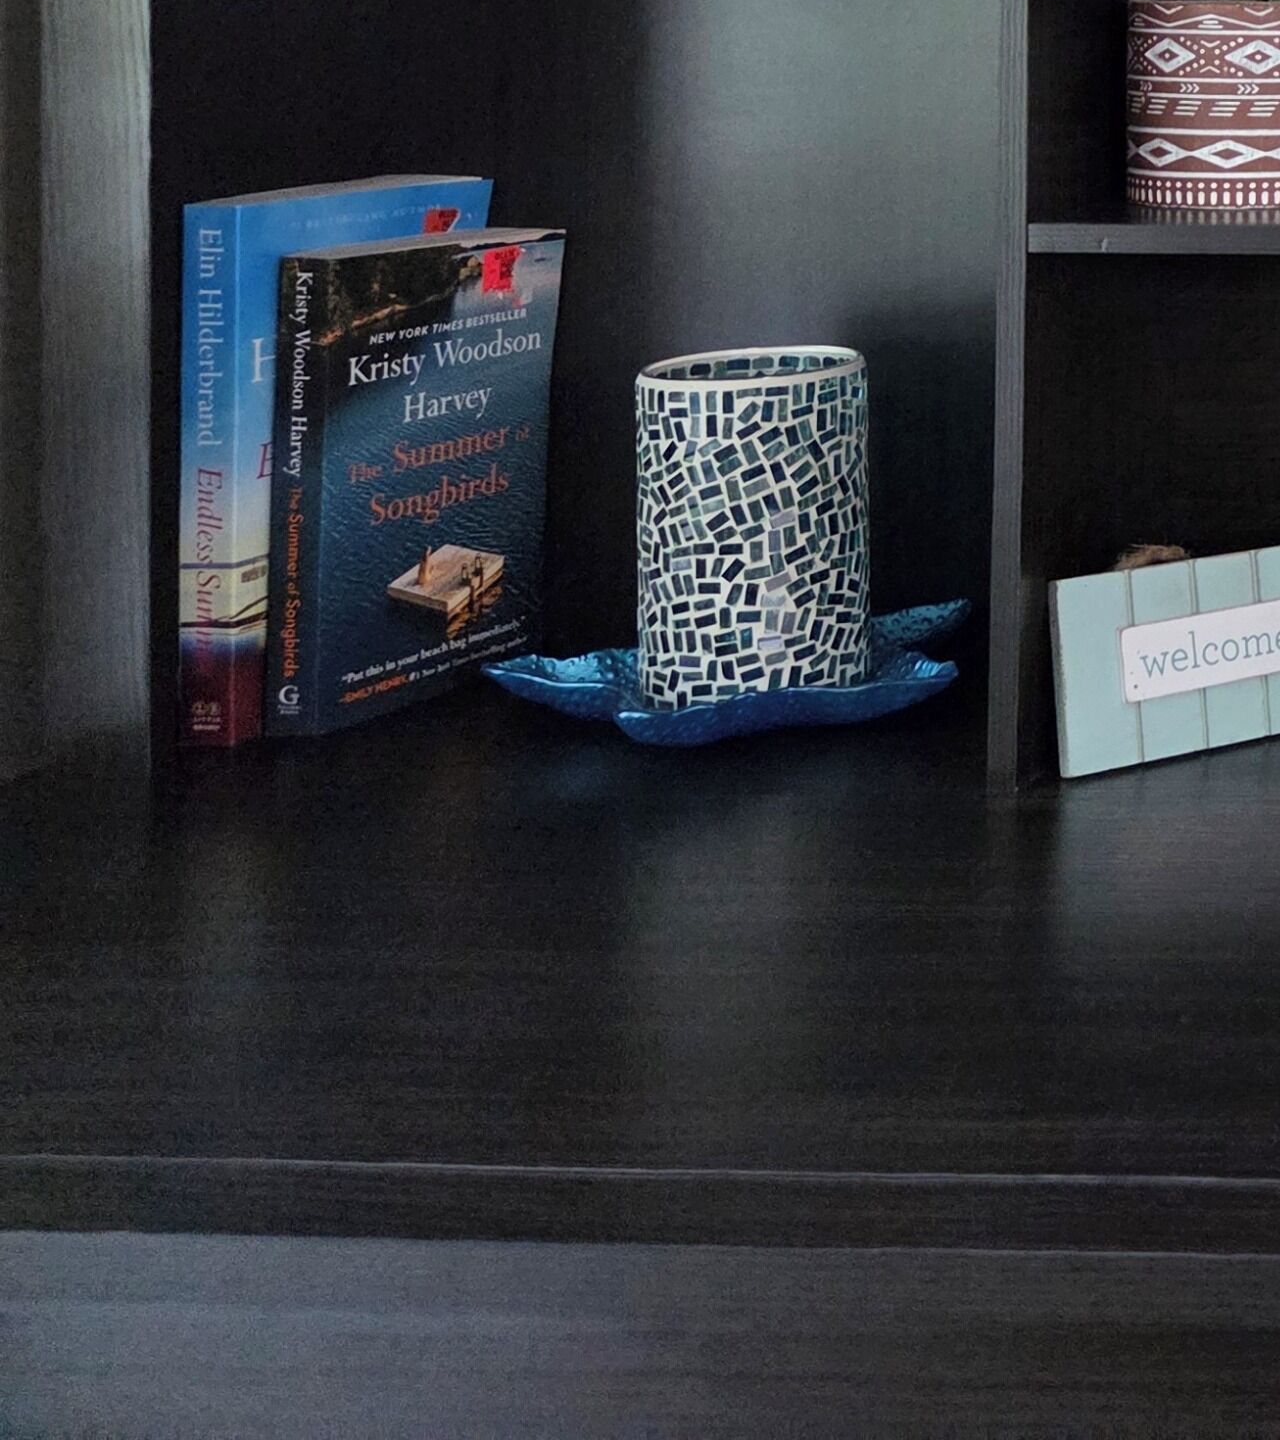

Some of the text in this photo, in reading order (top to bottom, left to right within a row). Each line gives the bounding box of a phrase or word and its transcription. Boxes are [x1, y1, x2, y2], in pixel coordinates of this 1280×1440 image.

[199, 228, 224, 278] Elin
[289, 271, 314, 322] Kristy
[369, 307, 528, 346] NEW YORK TIMES BESTSELLER
[198, 289, 224, 447] Hilderbrand
[292, 329, 312, 411] Woodson
[348, 328, 542, 386] Kristy Woodson
[402, 387, 493, 423] Harvey
[282, 416, 308, 478] Harvey
[347, 461, 384, 484] The
[393, 425, 511, 474] Summer
[197, 468, 222, 564] Endless
[369, 462, 510, 526] Songbirds
[287, 514, 304, 579] Summer
[280, 597, 301, 678] Songbirds
